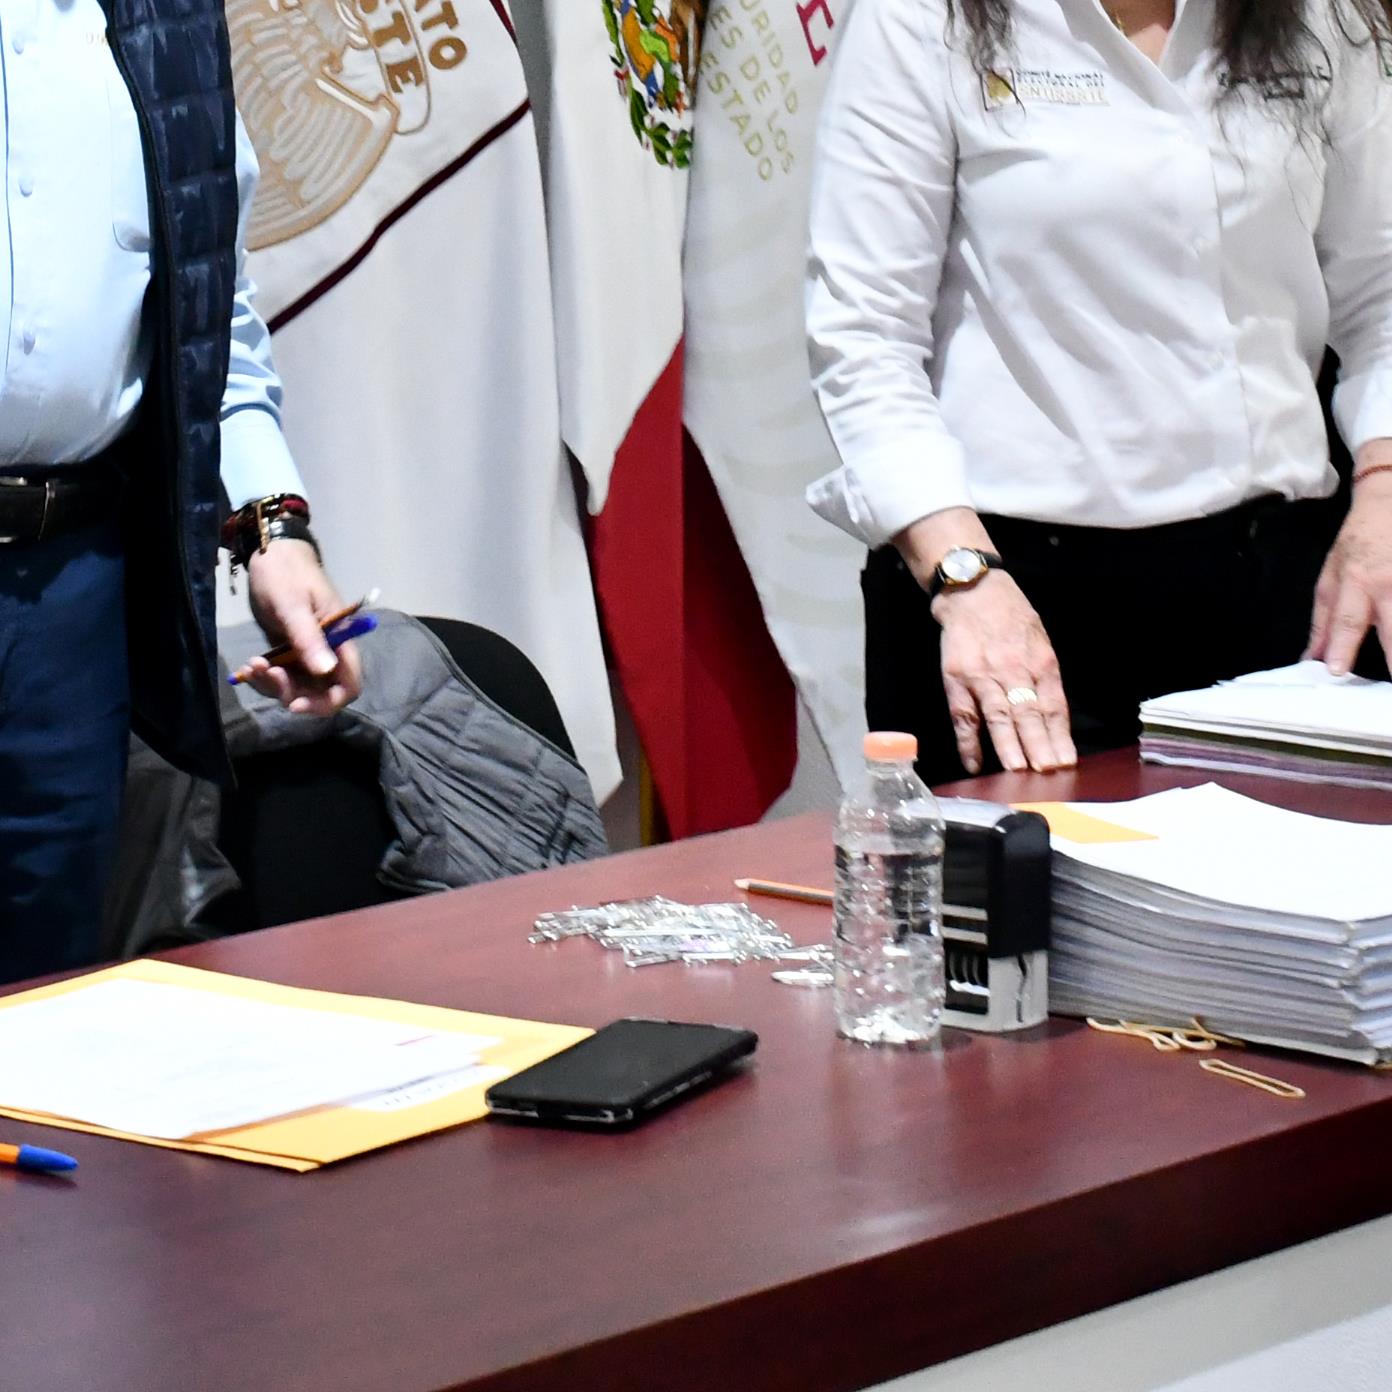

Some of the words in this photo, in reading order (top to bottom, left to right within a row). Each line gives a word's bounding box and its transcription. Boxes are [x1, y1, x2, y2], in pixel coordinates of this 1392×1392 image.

[700, 49, 773, 182] ESTADO
[740, 56, 772, 105] DE
[767, 110, 795, 175] LOS
